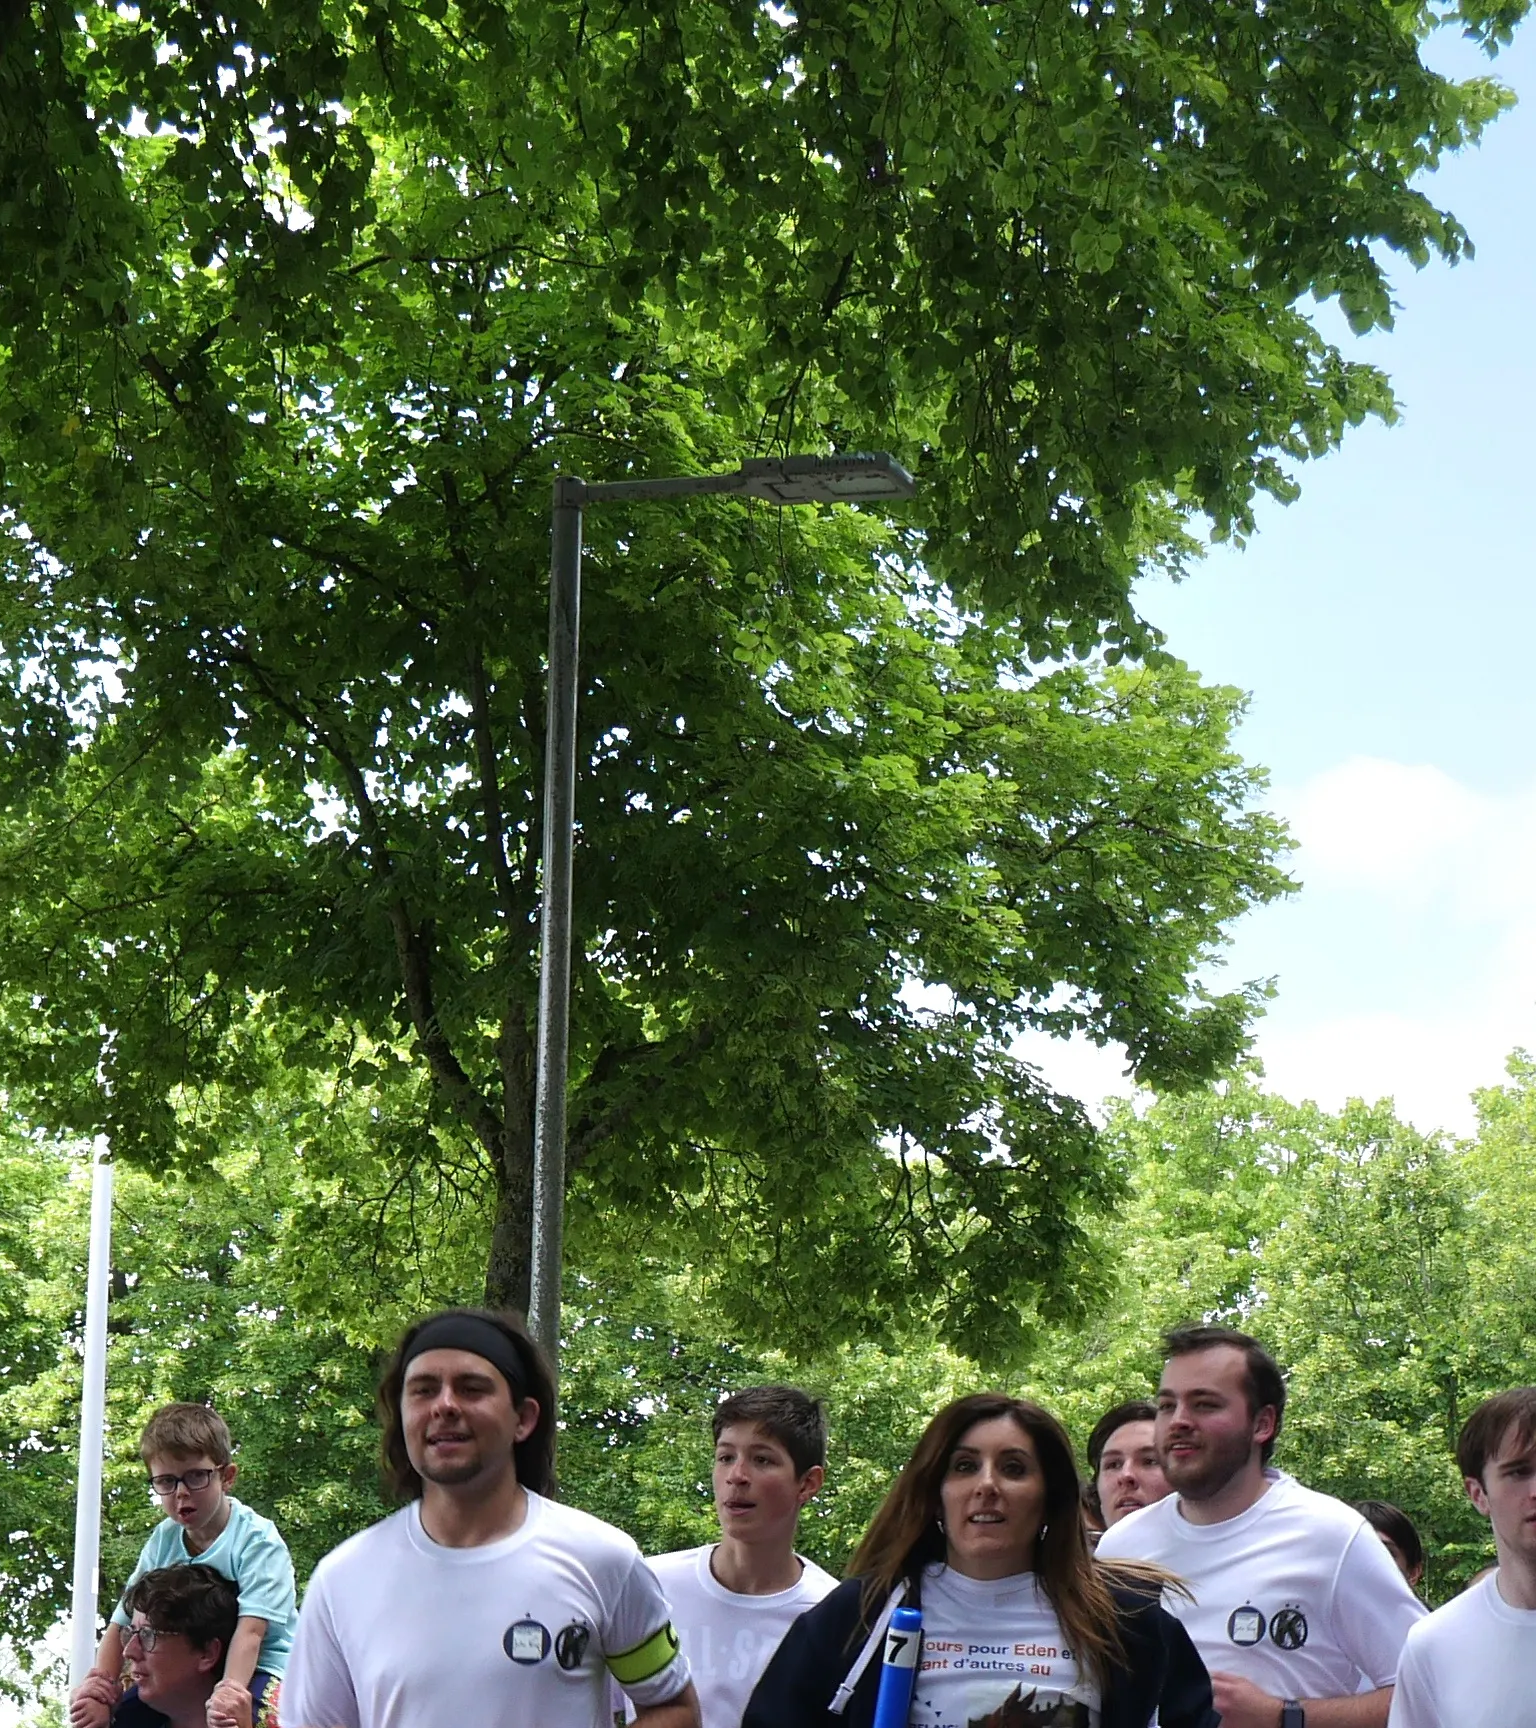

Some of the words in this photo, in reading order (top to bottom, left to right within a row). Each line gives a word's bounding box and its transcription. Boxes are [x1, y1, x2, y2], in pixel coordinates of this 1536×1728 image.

[888, 1634, 908, 1663] 7
[921, 1639, 962, 1653] ours
[968, 1644, 1010, 1655] pour
[1014, 1643, 1057, 1659] Eden
[921, 1658, 949, 1671] ant
[953, 1658, 1025, 1672] d'autres
[1030, 1663, 1052, 1676] au
